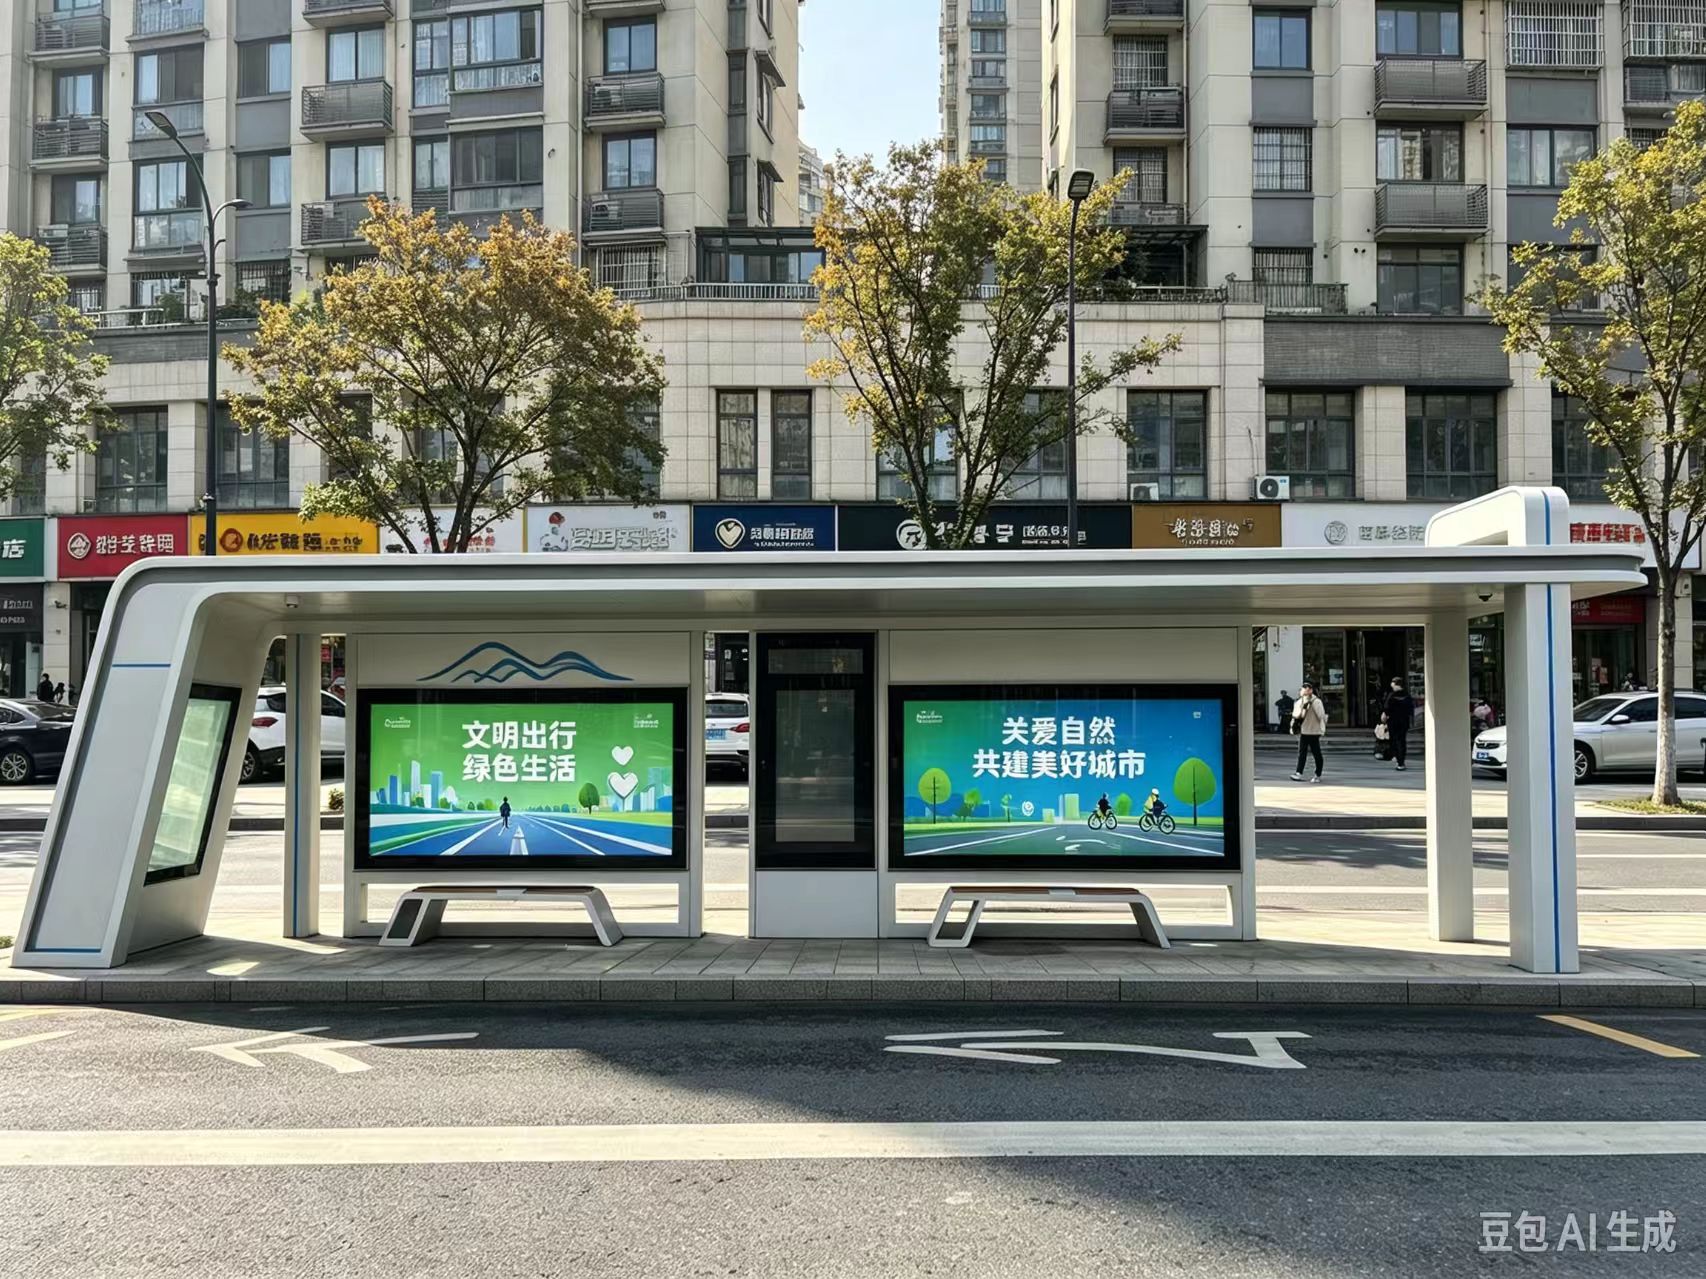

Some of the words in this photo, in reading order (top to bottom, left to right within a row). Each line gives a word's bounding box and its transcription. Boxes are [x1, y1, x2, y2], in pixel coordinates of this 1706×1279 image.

[462, 720, 577, 750] 文明出行
[1002, 716, 1116, 745] 关爱自然
[462, 753, 577, 783] 绿色生活
[972, 748, 1147, 779] 共建美好城市
